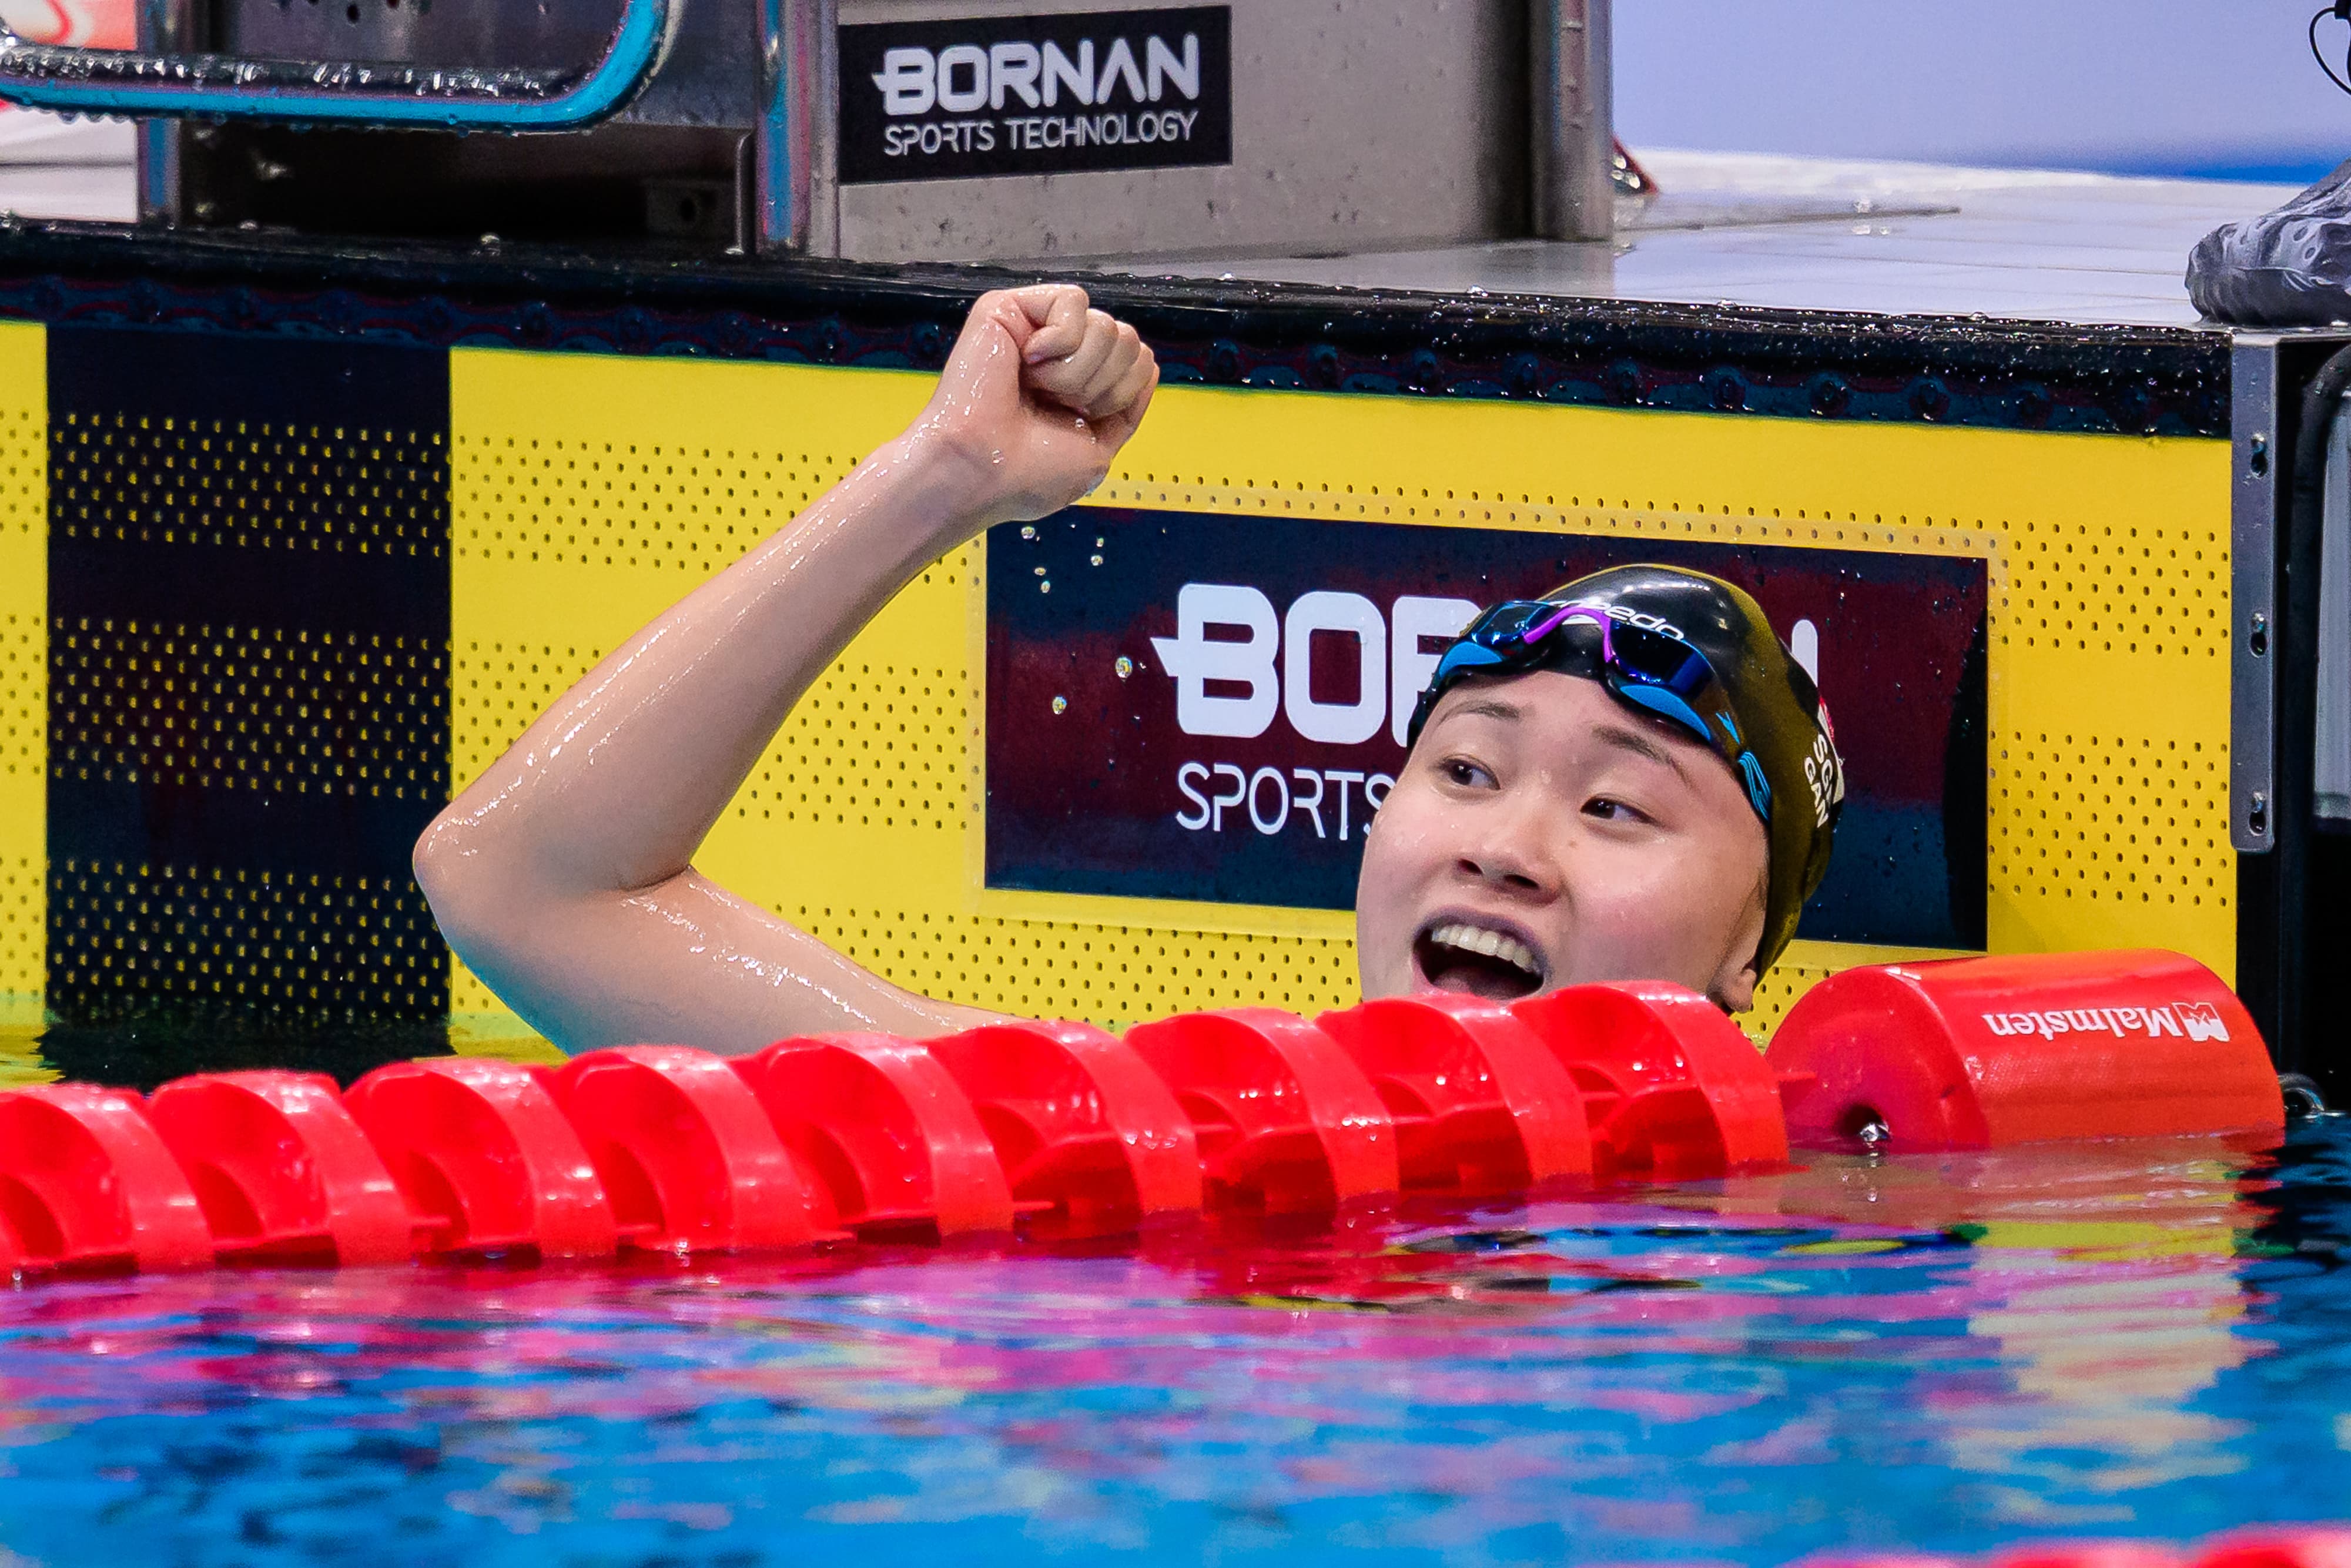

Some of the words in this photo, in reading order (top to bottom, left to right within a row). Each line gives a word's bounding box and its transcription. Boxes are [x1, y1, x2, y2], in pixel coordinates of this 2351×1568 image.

[872, 32, 1200, 115] BORNAN
[884, 120, 994, 156] SPORTS
[1006, 110, 1198, 150] TECHNOLOGY
[1804, 756, 1829, 828] GAN
[1981, 1006, 2185, 1041] Malmsten
